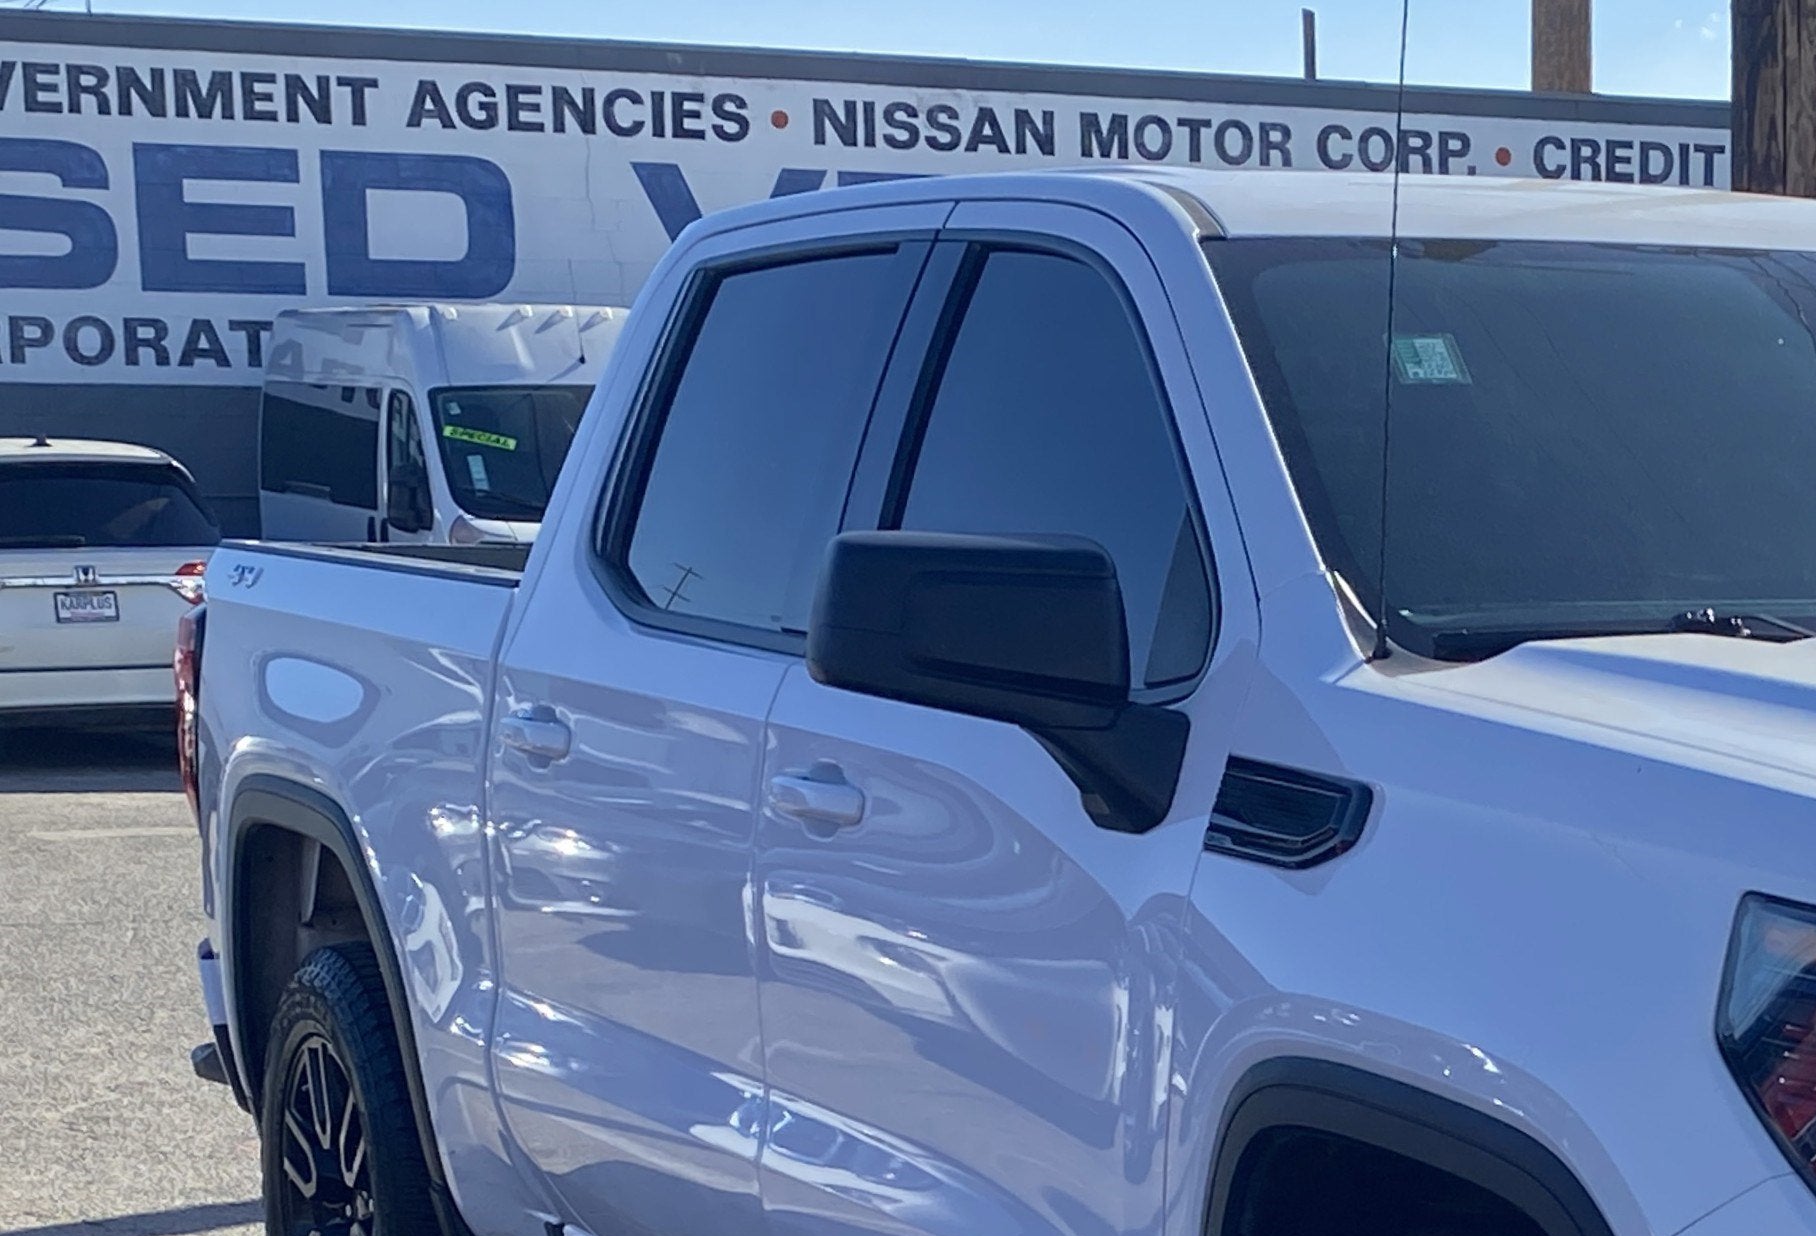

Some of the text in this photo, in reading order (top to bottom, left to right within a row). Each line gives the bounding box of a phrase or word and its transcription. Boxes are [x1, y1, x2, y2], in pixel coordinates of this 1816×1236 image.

[406, 79, 751, 142] AGENCIES
[813, 98, 1477, 177] NISSAN MOTOR CORP.
[1533, 136, 1726, 187] CREDIT
[0, 137, 517, 299] SED
[0, 315, 274, 369] PORAT
